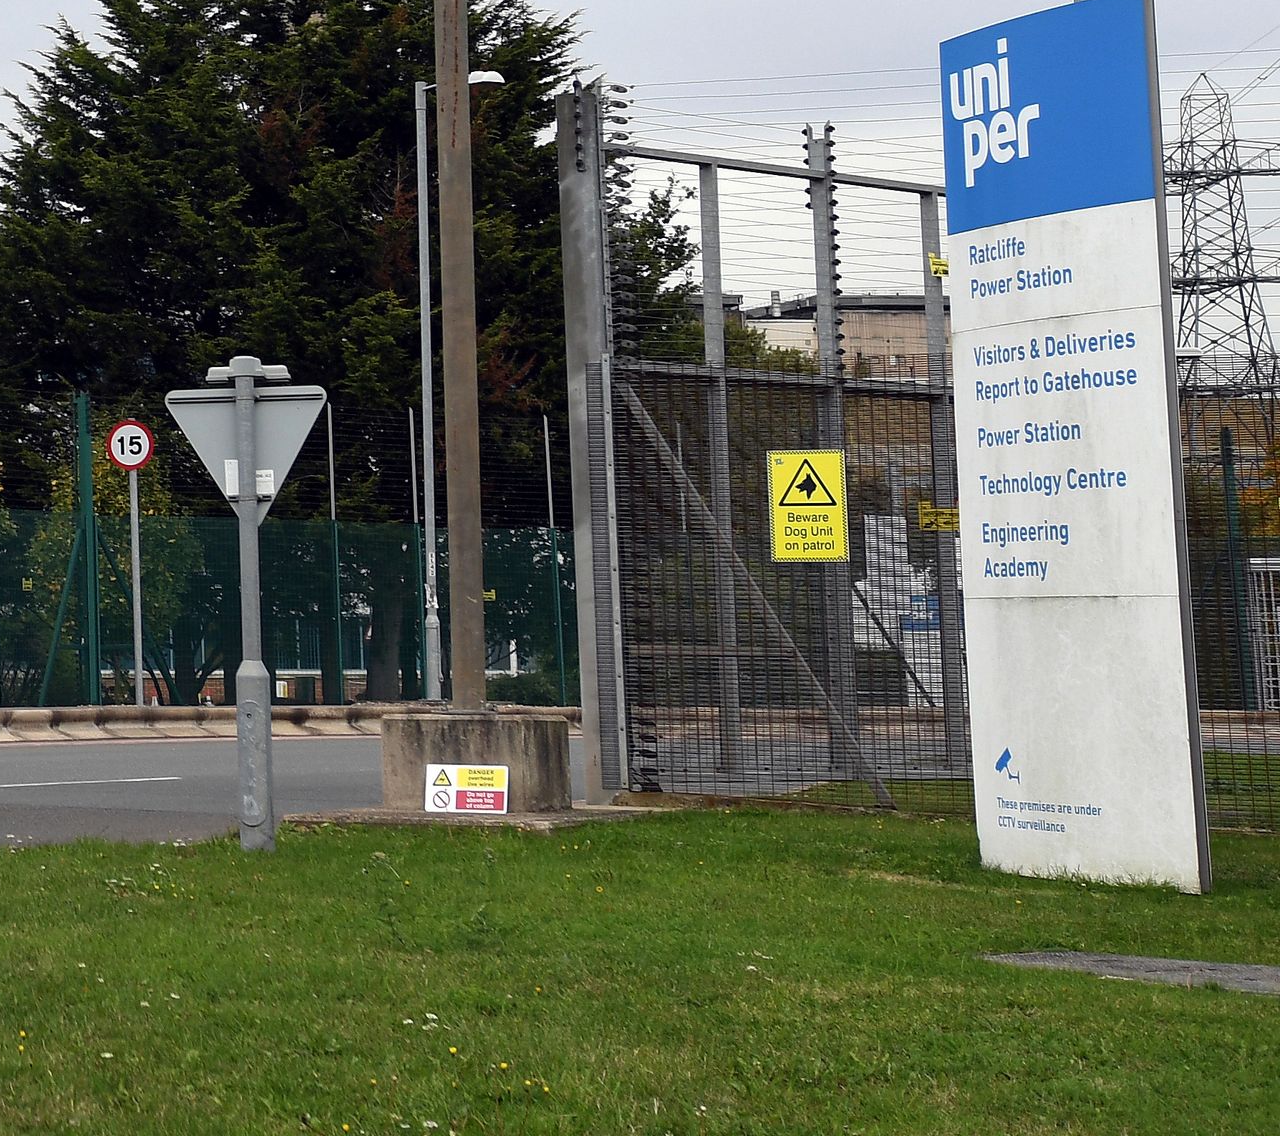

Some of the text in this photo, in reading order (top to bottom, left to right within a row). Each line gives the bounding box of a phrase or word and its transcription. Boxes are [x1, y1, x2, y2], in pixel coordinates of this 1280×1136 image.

[949, 37, 1011, 122] uni
[963, 103, 1040, 188] per
[969, 237, 1026, 266] Ratcliffe
[971, 265, 1073, 299] Power Station
[973, 329, 1136, 367] Visitors & Deliveries
[975, 366, 1138, 403] Report to Gatehouse
[118, 435, 142, 455] 15
[977, 421, 1081, 449] Power Station
[979, 467, 1127, 499] Technology Centre
[787, 512, 829, 523] Beware
[784, 526, 833, 539] Dog Unit
[785, 540, 835, 552] on patrol
[982, 520, 1070, 547] Engineering
[983, 558, 1049, 582] Academy
[996, 797, 1102, 818] These premises are under
[997, 815, 1066, 834] CCTV surveillance
